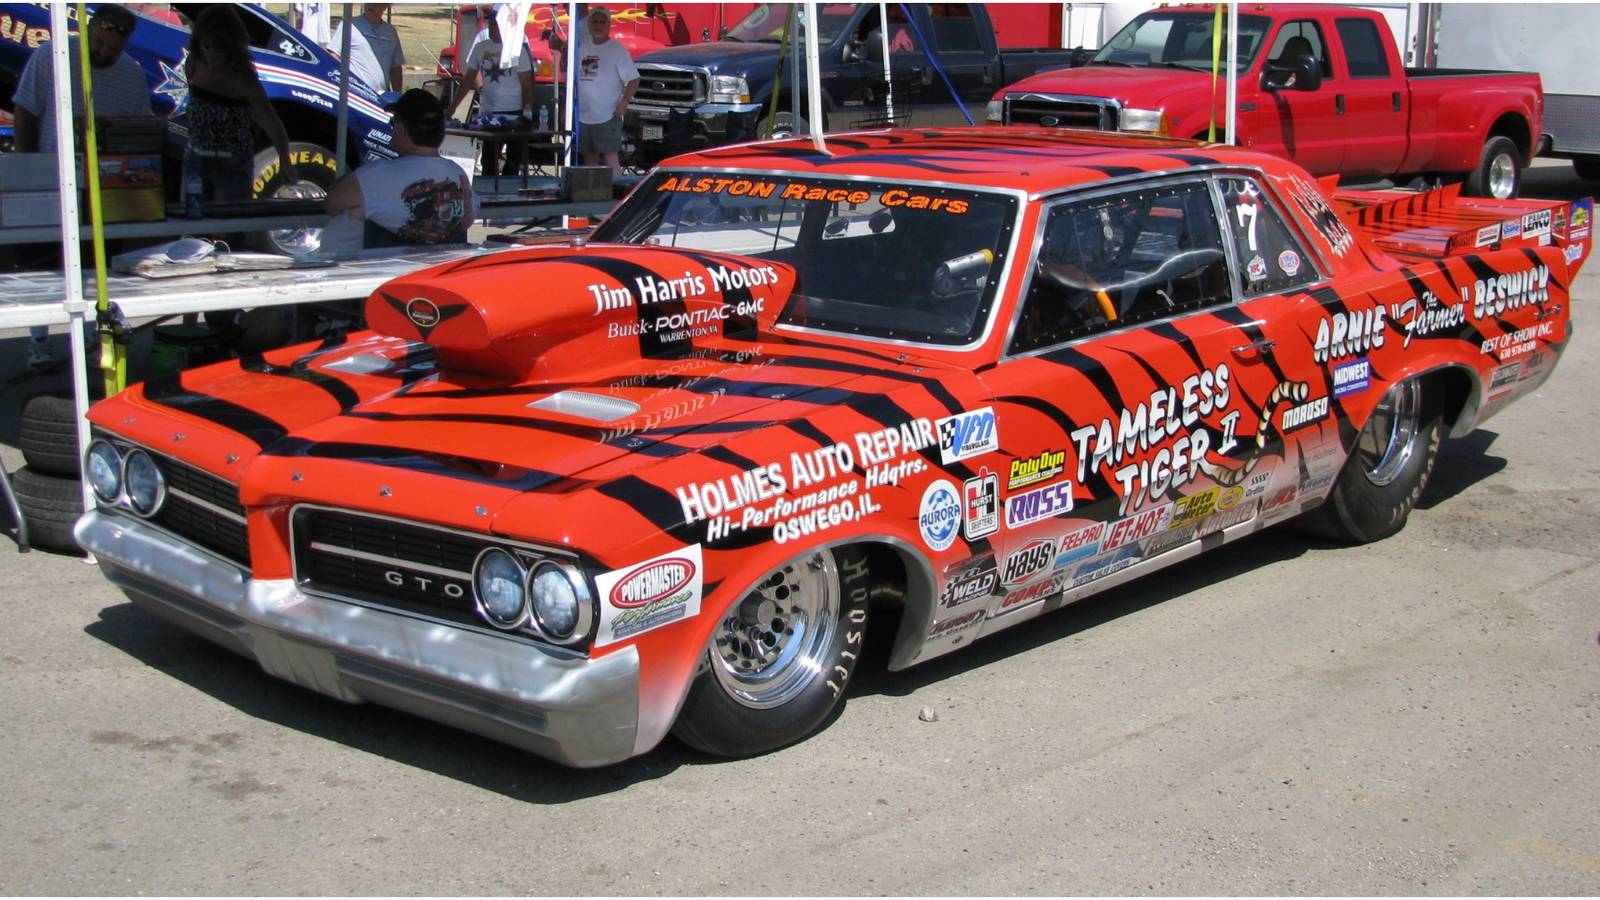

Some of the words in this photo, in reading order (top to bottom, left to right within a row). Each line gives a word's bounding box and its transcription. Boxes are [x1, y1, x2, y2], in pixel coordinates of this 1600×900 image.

[657, 177, 775, 199] ALSTON
[780, 183, 870, 204] Race
[879, 189, 969, 215] Cars
[1236, 203, 1257, 251] 7
[588, 283, 632, 317] Jim
[635, 271, 706, 304] Harris
[707, 264, 779, 293] Motors
[1314, 304, 1387, 362] ARNIE
[1474, 265, 1550, 319] BESWICK
[1480, 336, 1500, 354] BEST
[1500, 333, 1512, 348] OF
[1512, 325, 1538, 345] SHOW
[1334, 361, 1368, 386] MIDWEST
[1070, 363, 1230, 483] TAMELESS
[676, 463, 787, 524] HOLMES
[790, 442, 853, 489] AUTO
[854, 417, 936, 468] REPAIR
[1115, 428, 1210, 517] TIGER
[707, 480, 858, 542] Hi-Performance
[865, 456, 928, 490] Hdqtrs.
[921, 504, 960, 527] AURORA
[971, 494, 993, 508] HURST
[1009, 482, 1070, 525] ROSS
[1060, 524, 1104, 552] FEL-PRO
[1102, 507, 1166, 551] JET-HOT
[621, 565, 686, 602] POWERMASTER
[953, 574, 993, 600] WELD
